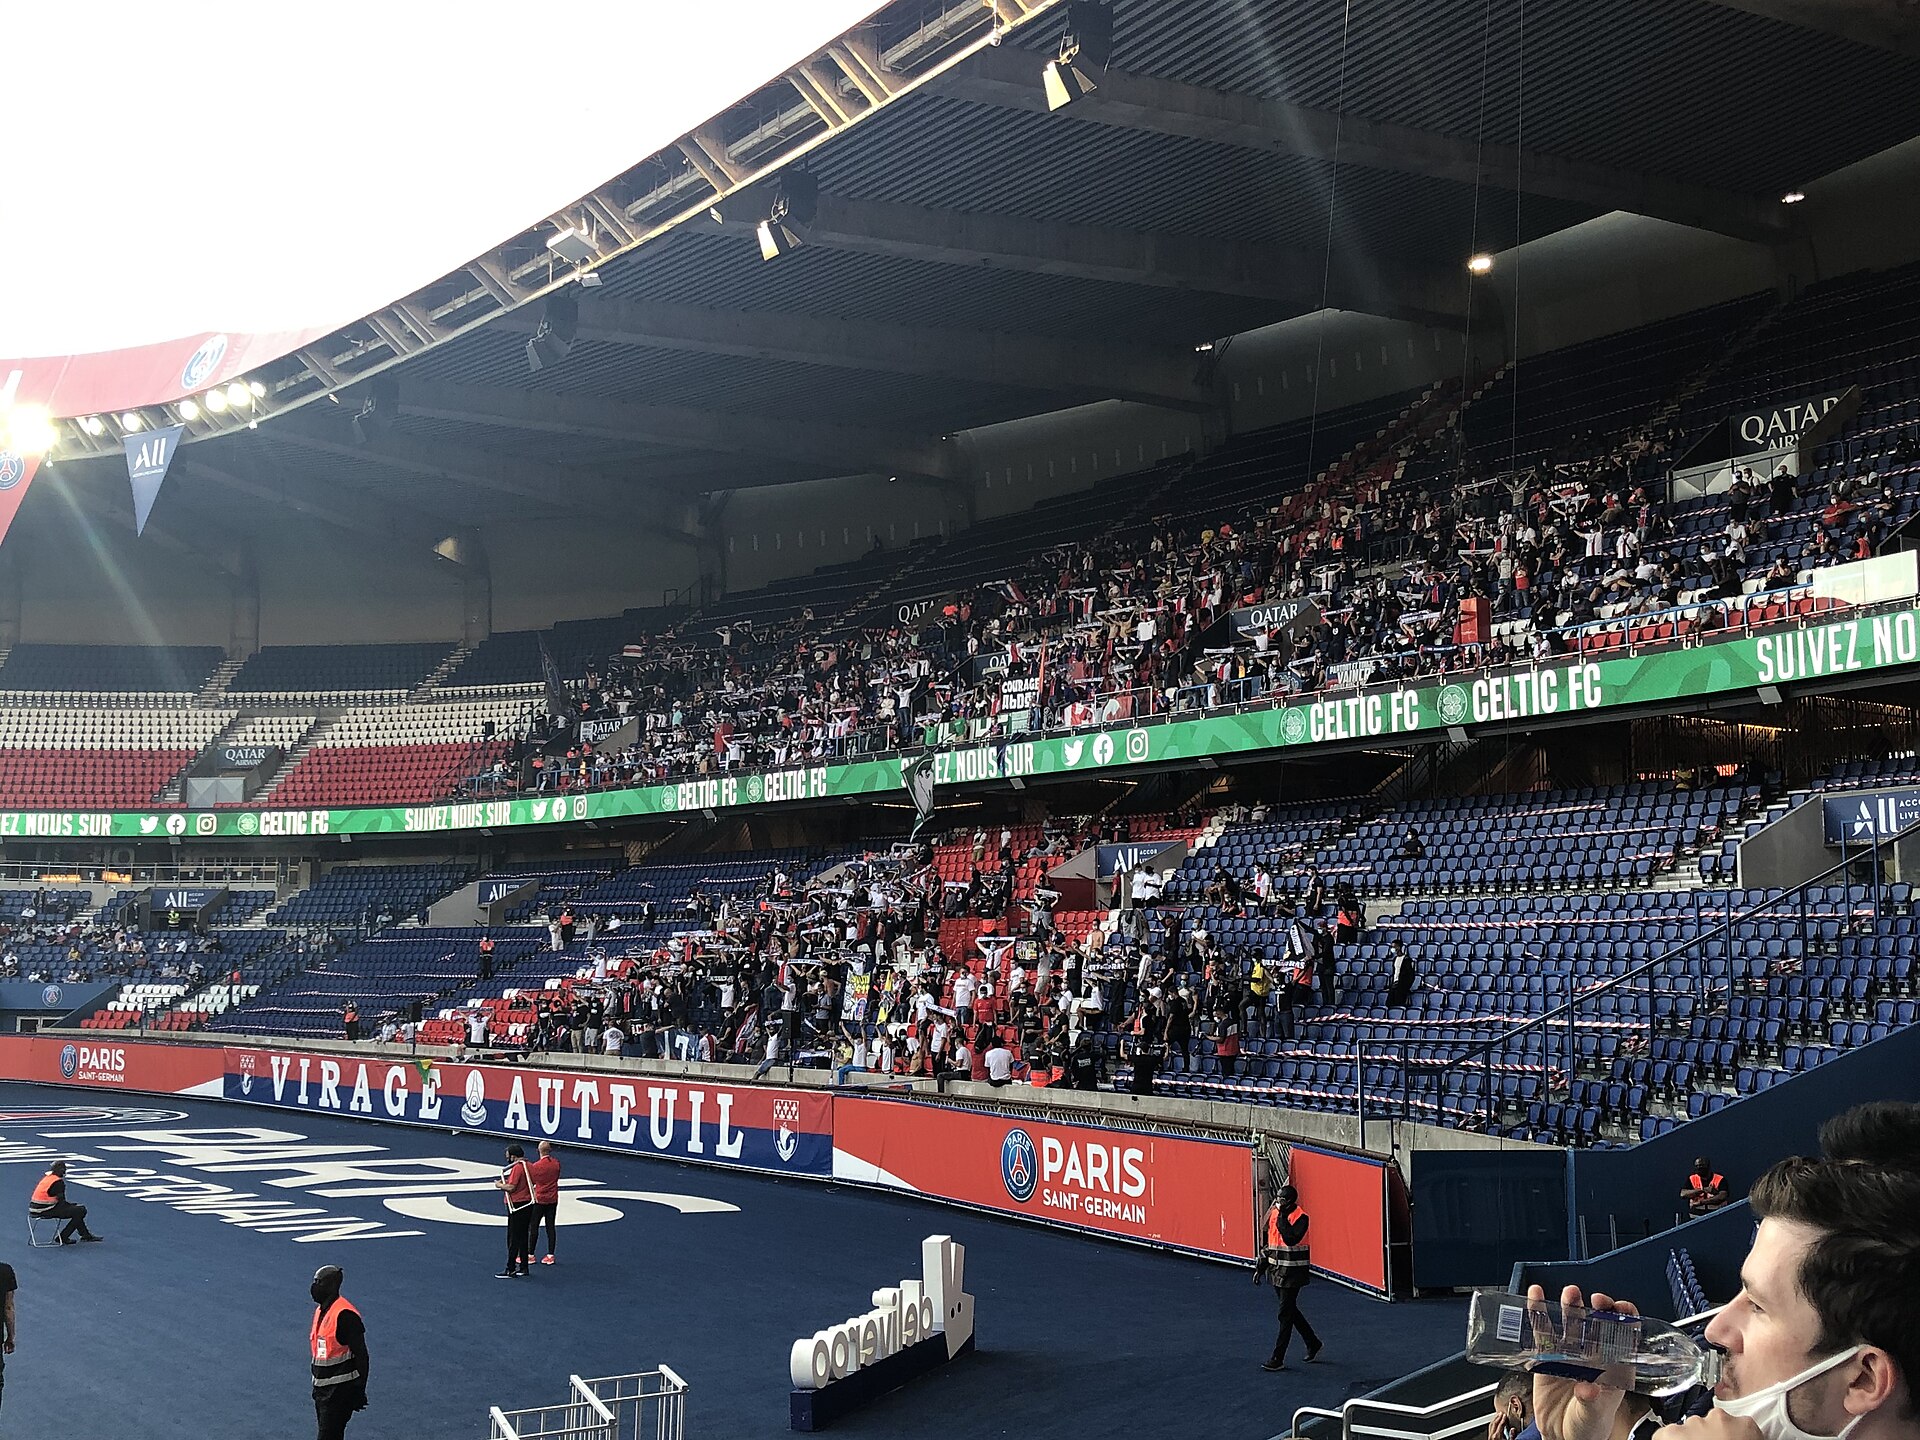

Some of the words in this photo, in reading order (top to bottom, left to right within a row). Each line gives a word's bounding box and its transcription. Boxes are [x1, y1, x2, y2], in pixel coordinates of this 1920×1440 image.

[1757, 621, 1861, 683] SUIVEZ
[1872, 612, 1920, 665] NO
[1002, 677, 1040, 693] COURAGE
[1472, 669, 1557, 723] CELTIC
[1568, 662, 1601, 709] FC
[1310, 695, 1381, 742] CELTIC
[1391, 689, 1419, 732] FC
[225, 748, 266, 761] QATAR
[956, 746, 997, 781] NOUS
[1005, 743, 1034, 776] SUR
[678, 780, 718, 811] CELTIC
[721, 777, 737, 806] FC
[764, 769, 807, 803] CELTIC
[810, 767, 827, 798] FC
[405, 806, 448, 831] SUIVEZ
[451, 803, 483, 829] NOUS
[486, 801, 511, 826] SUR
[1899, 799, 1920, 807] ACC
[0, 813, 20, 835] EZ
[26, 813, 72, 835] NOUS
[79, 813, 111, 836] SUR
[259, 811, 307, 835] CELTIC
[311, 810, 329, 834] FC
[79, 1047, 125, 1072] PARIS
[270, 1056, 442, 1120] VIRAGE
[503, 1075, 745, 1159] AUTEUIL
[1007, 1133, 1031, 1151] PARIS
[1042, 1136, 1146, 1198] PARIS
